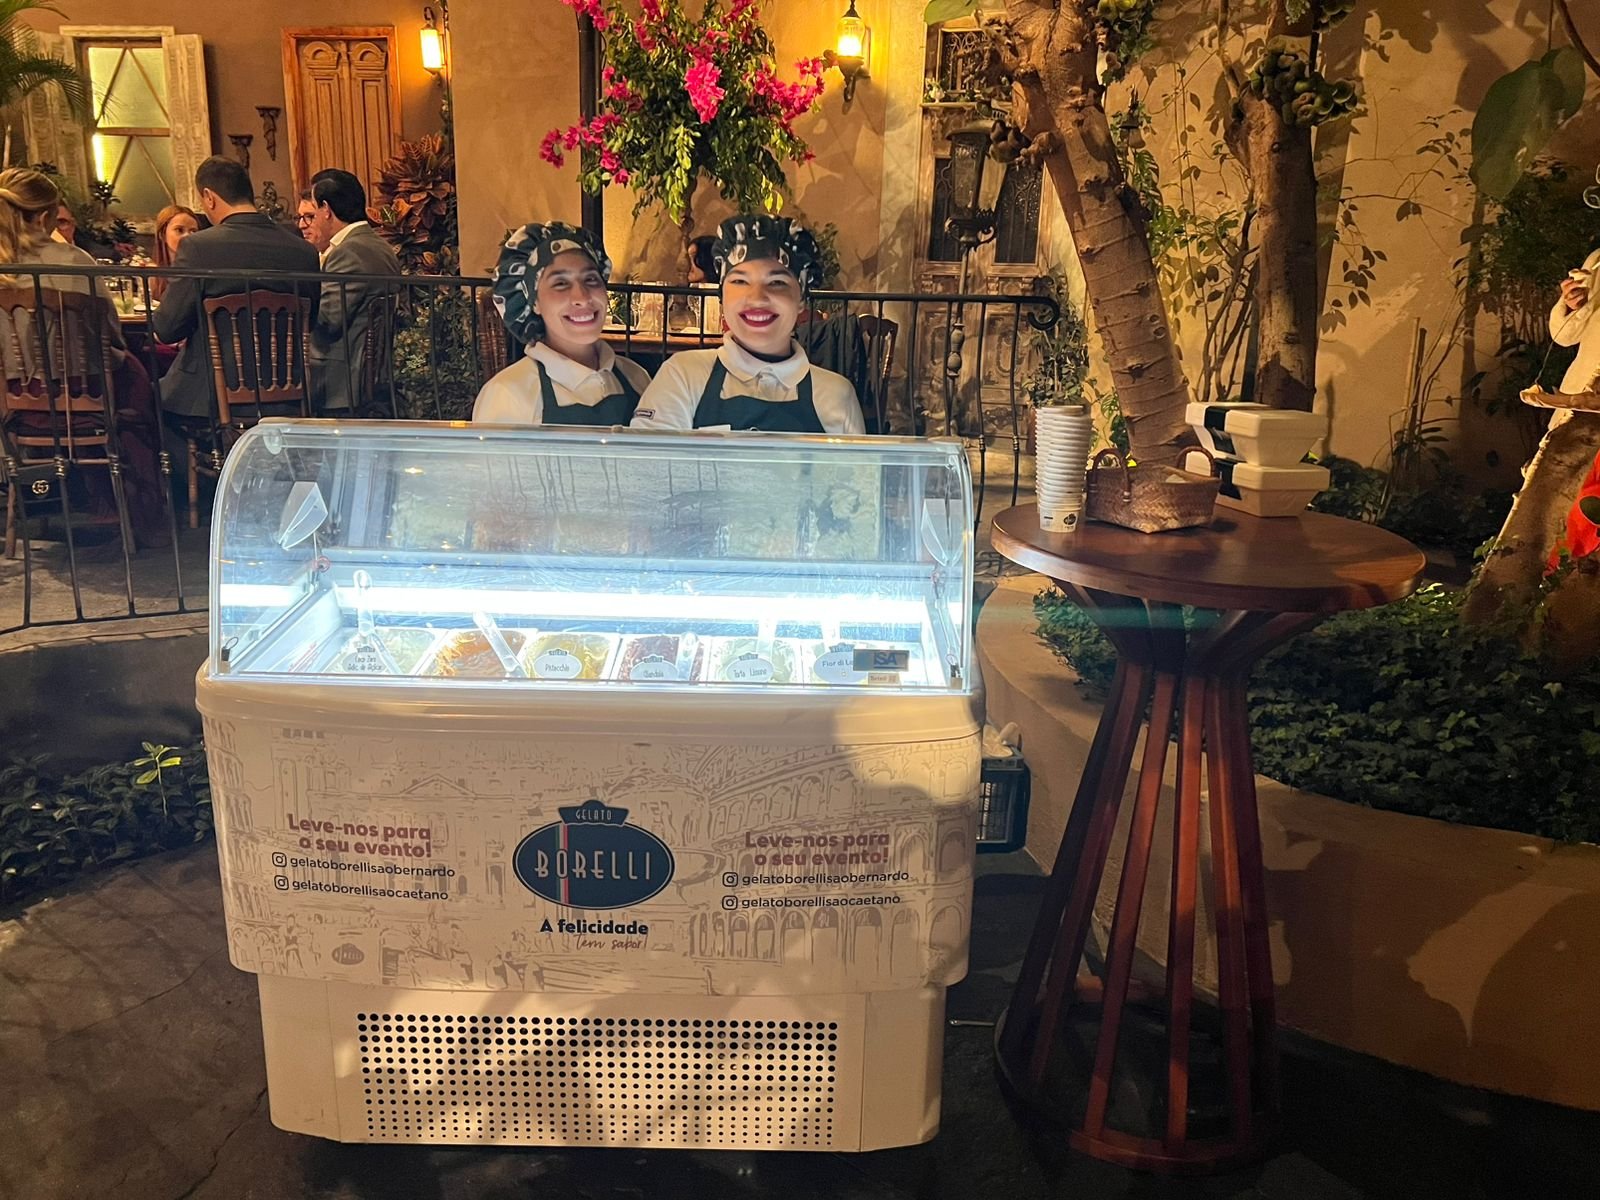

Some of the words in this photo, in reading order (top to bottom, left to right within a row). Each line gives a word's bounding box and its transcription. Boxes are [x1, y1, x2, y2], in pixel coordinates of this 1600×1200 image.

[575, 809, 612, 821] GELATO
[287, 813, 379, 837] Leve-nos
[383, 825, 431, 842] para
[299, 837, 311, 849] o
[315, 837, 350, 853] seu
[354, 842, 432, 858] evento!
[745, 831, 839, 848] Leve-nos
[843, 833, 890, 850] para
[535, 849, 650, 880] BORELLI
[754, 854, 767, 866] o
[771, 852, 807, 866] seu
[811, 847, 889, 866] evento!
[290, 857, 455, 877] gelatoborellisaobernardo
[742, 870, 909, 886] gelatoborellisaobernardo
[292, 879, 449, 900] gelatoborellisaocaetano
[741, 895, 901, 910] gelatoborellisaocaetano
[540, 918, 553, 933] A
[557, 918, 649, 935] felicidade
